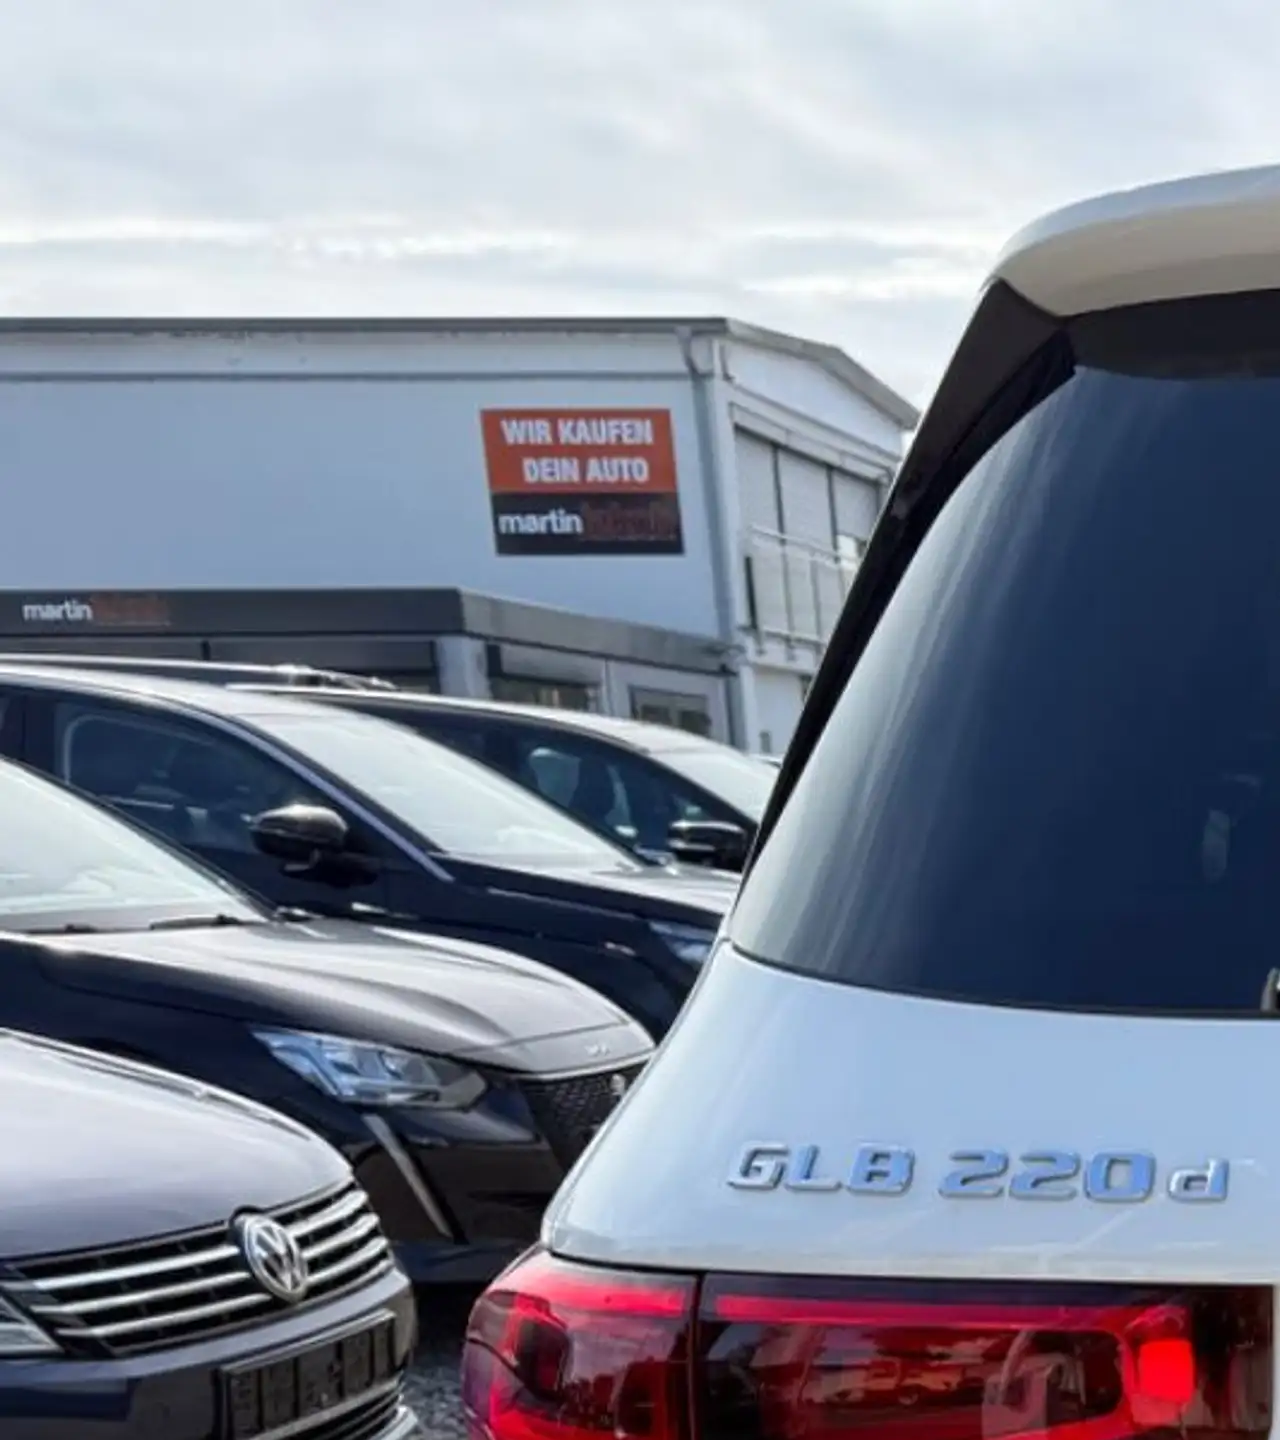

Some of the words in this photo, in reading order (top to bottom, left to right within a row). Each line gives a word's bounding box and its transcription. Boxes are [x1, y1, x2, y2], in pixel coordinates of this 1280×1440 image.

[501, 420, 553, 445] WIR
[557, 418, 653, 445] KAUFEN
[522, 457, 580, 484] DEIN
[585, 457, 649, 482] AUTO
[498, 508, 584, 534] martin
[22, 597, 94, 621] martin
[726, 1142, 915, 1195] GLB
